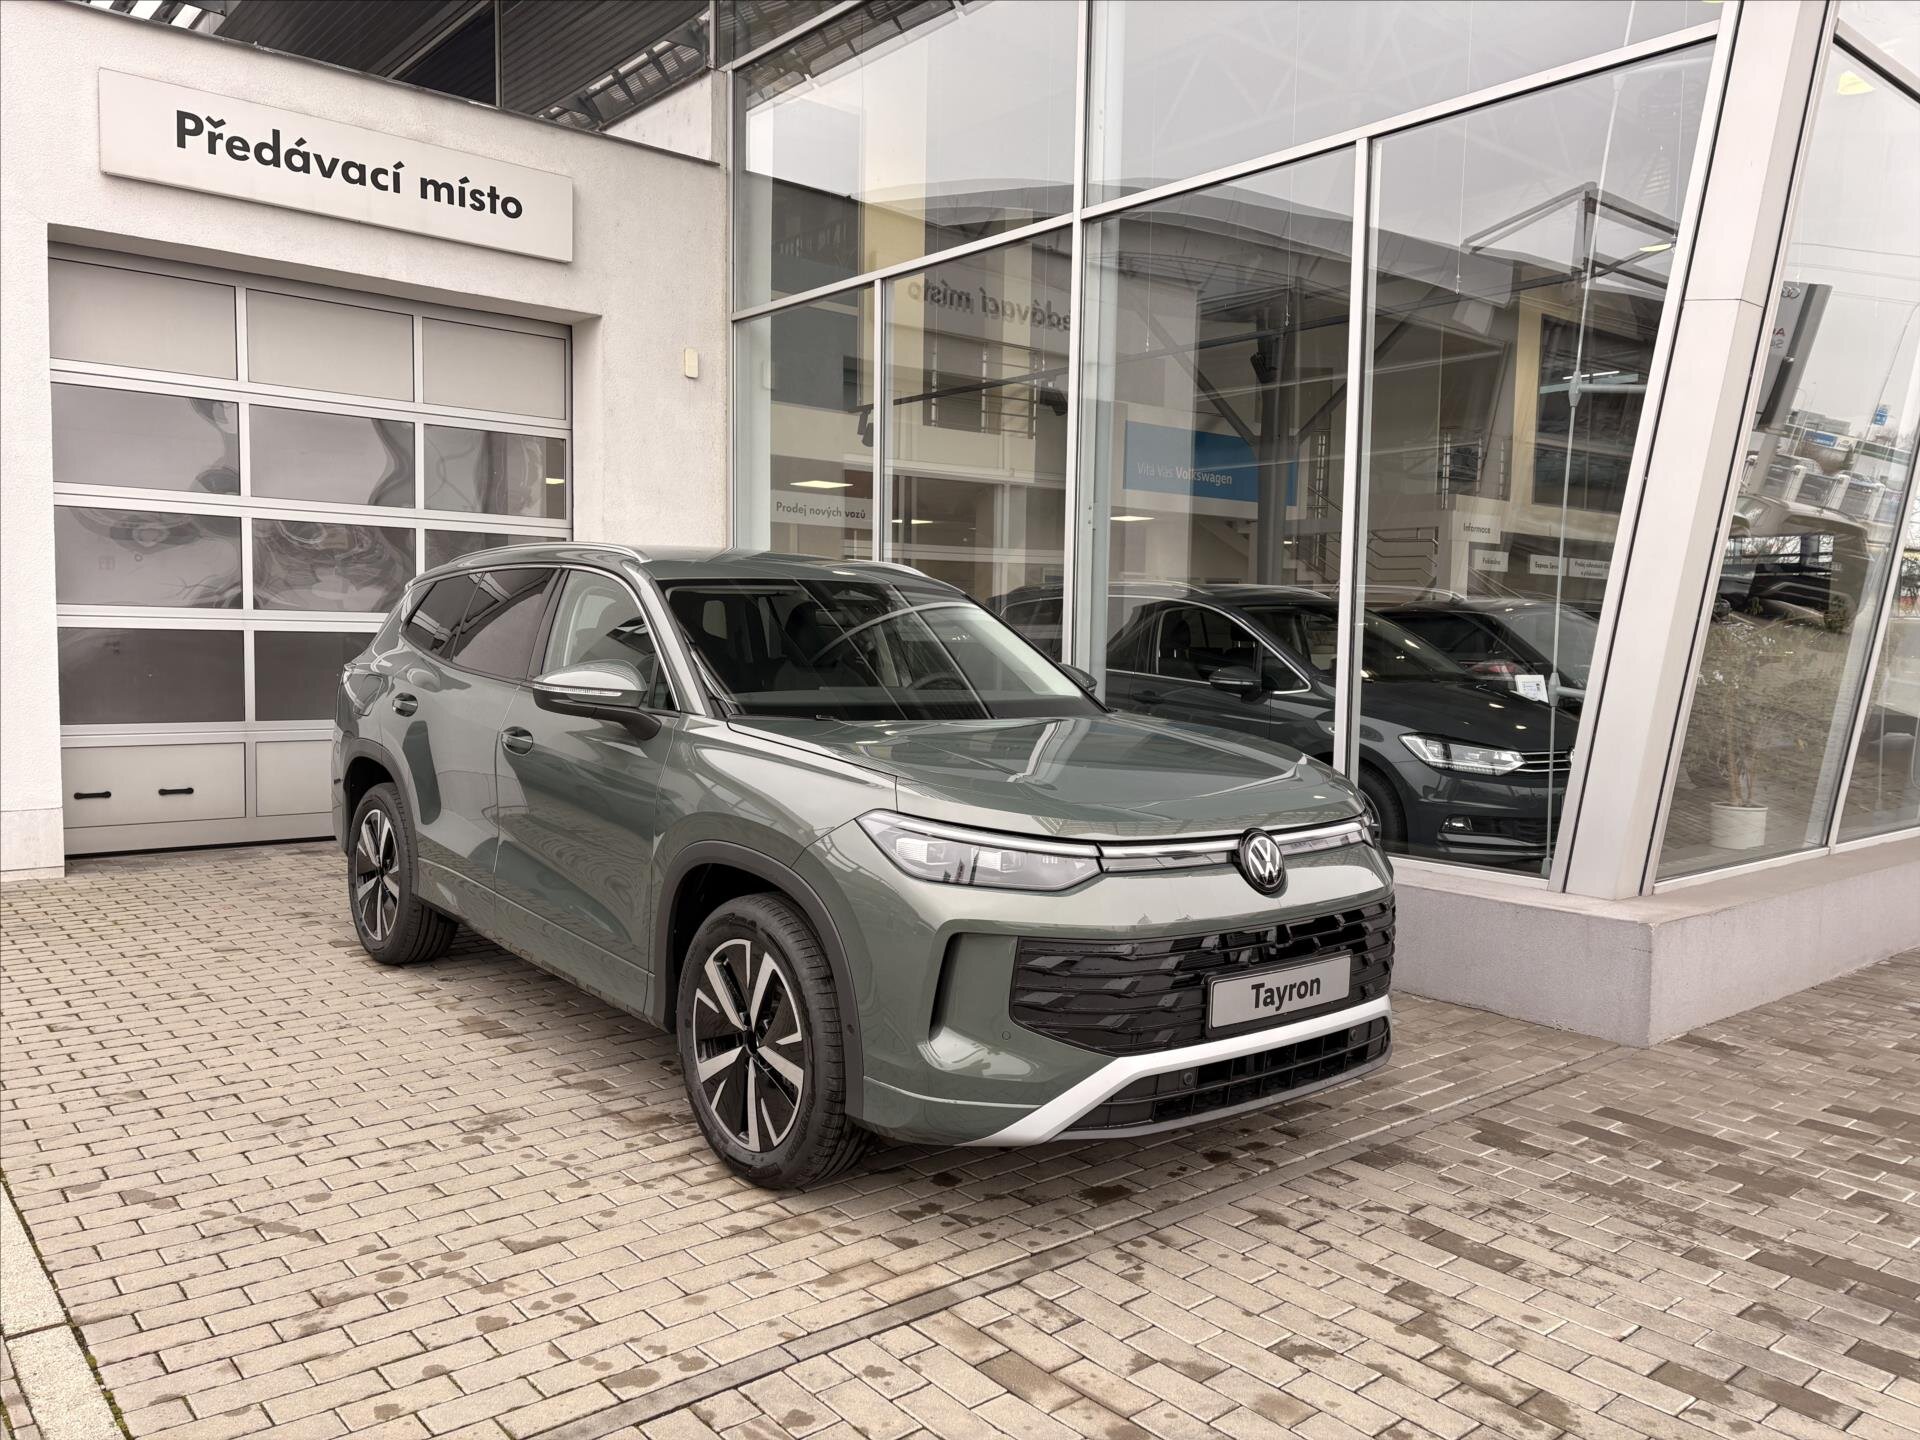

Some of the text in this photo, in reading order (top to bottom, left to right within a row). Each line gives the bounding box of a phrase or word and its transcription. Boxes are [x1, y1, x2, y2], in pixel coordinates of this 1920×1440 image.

[176, 109, 523, 219] Předávací místo
[1175, 466, 1232, 486] Volkswagen
[776, 501, 866, 519] Prodej nových vozů
[1463, 522, 1491, 534] Informace
[1251, 976, 1321, 1012] Tayron
